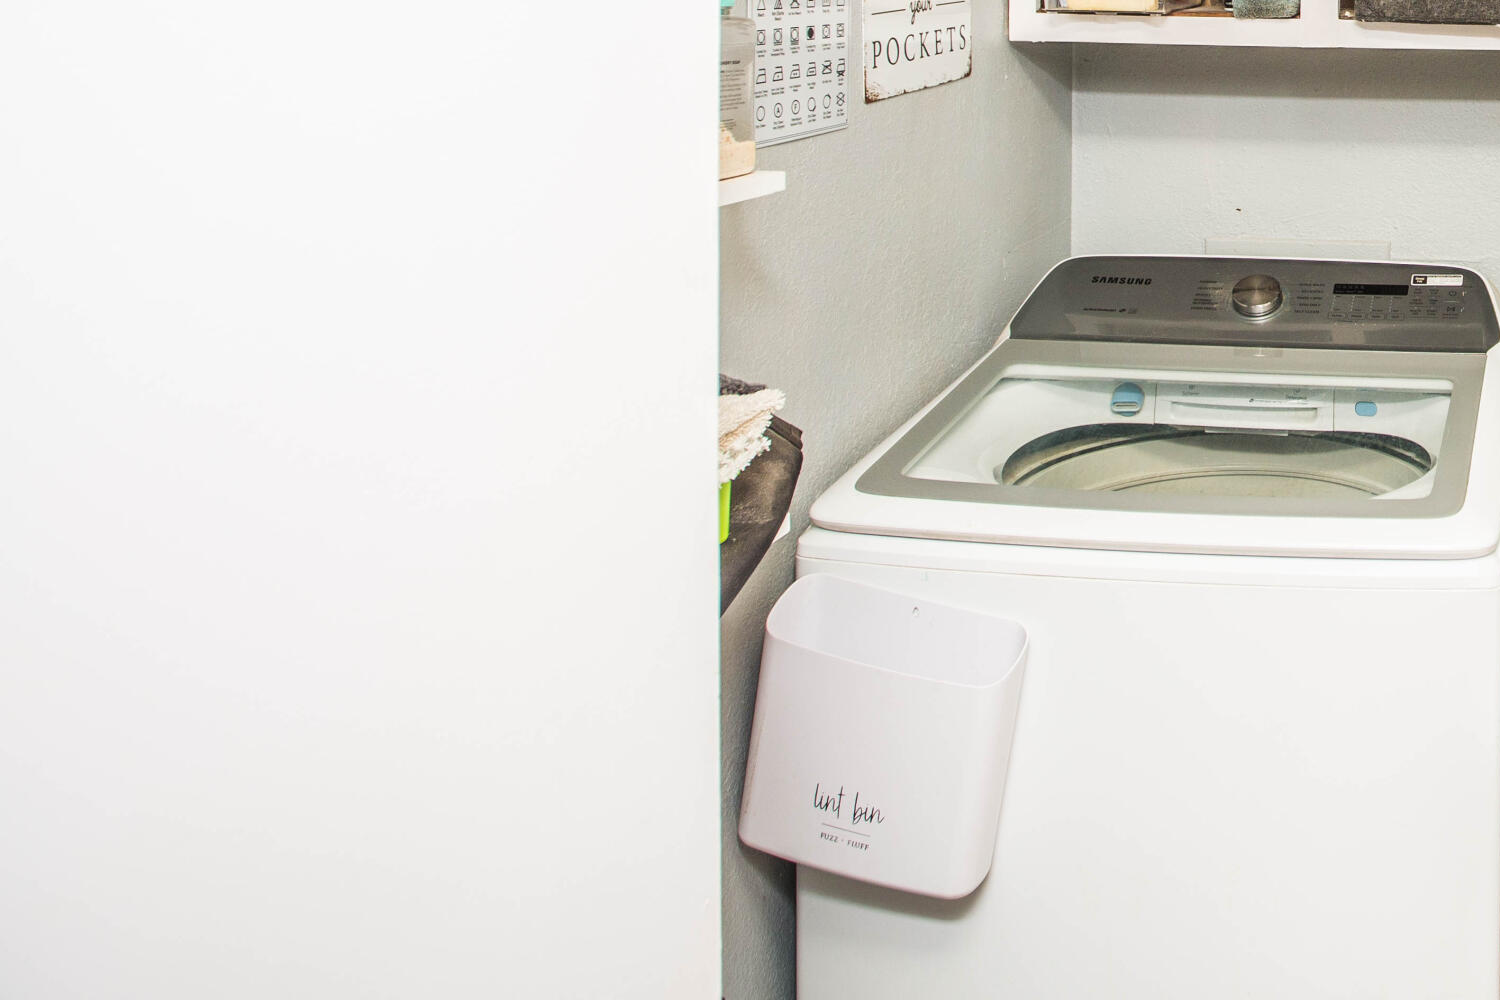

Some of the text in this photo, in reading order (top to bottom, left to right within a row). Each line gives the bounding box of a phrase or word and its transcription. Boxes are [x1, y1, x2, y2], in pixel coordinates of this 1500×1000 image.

[872, 24, 966, 69] POCKETS
[1091, 275, 1153, 285] SAMSUNG
[813, 782, 885, 825] lint bin
[820, 832, 839, 843] FUZZ
